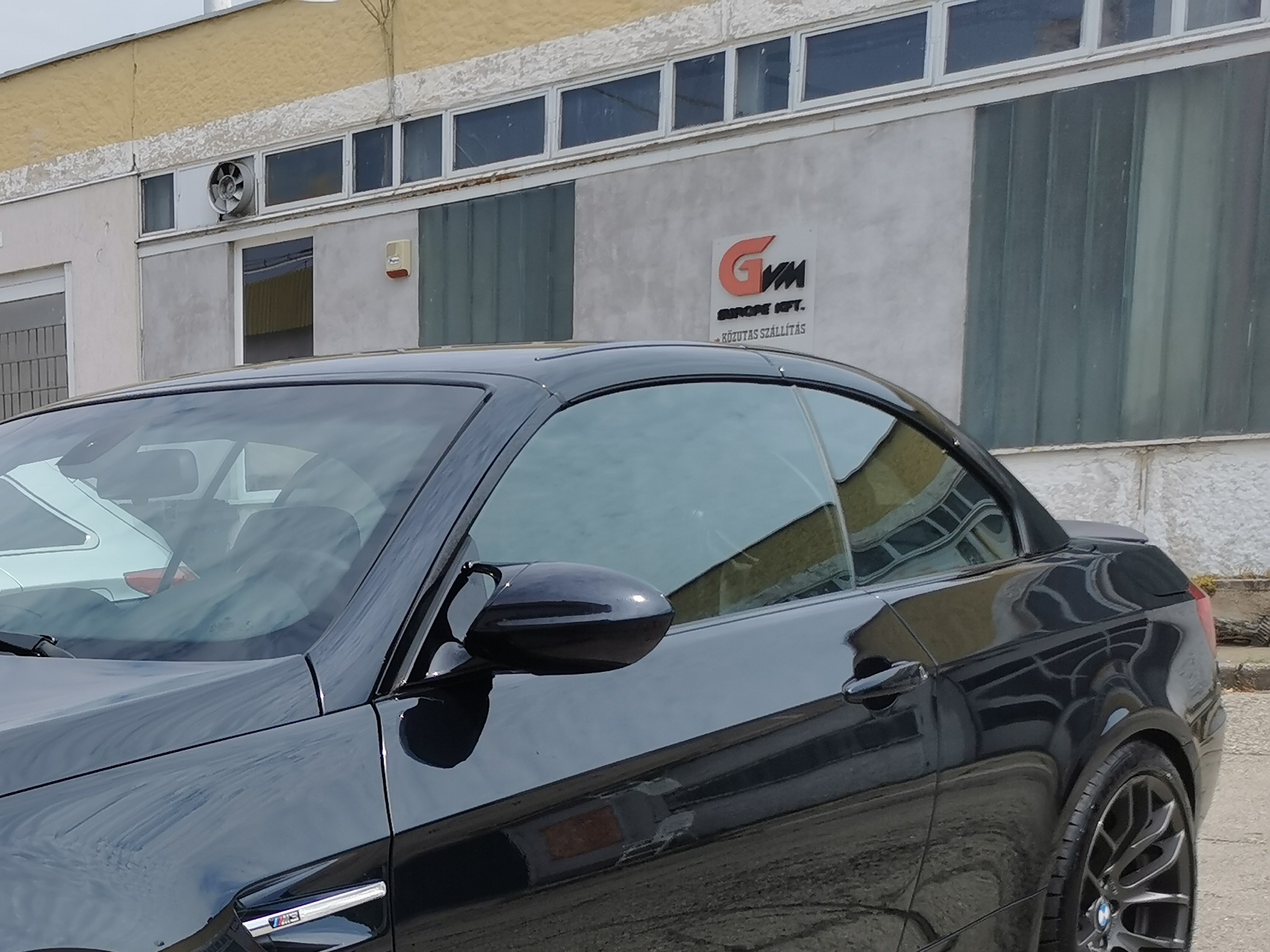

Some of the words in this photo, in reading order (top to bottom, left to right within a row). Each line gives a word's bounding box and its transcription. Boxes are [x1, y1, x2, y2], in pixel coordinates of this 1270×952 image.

[719, 235, 806, 296] GVM
[717, 303, 772, 321] EUROPE
[774, 299, 806, 315] KFT.
[760, 323, 806, 338] SZÁLLÍTÁS
